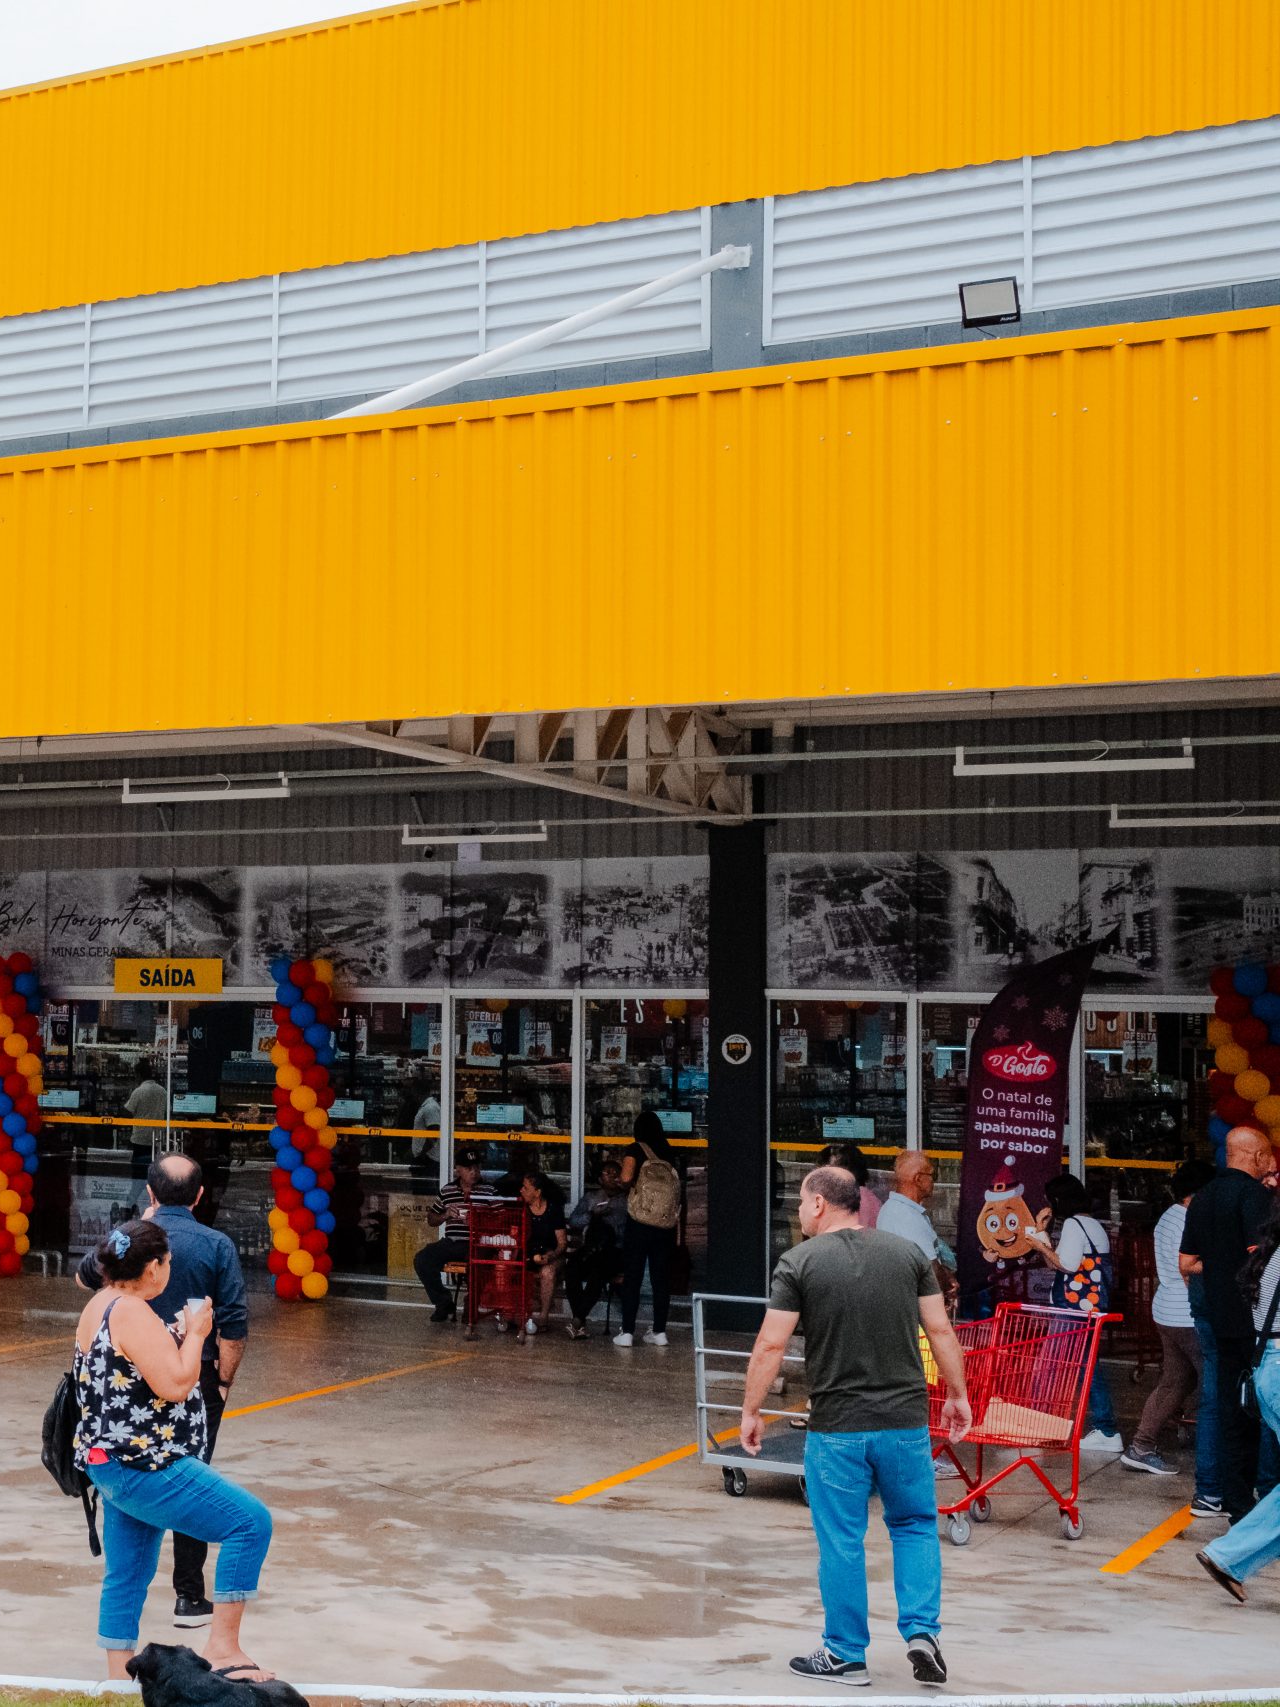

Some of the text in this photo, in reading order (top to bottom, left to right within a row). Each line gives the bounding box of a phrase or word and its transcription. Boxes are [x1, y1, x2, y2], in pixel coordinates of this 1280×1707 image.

[50, 900, 156, 942] Horizonte
[51, 947, 85, 957] MINAS
[139, 964, 196, 987] SAÍDA
[192, 1027, 203, 1040] 06
[492, 1031, 502, 1045] 08
[982, 1088, 1053, 1106] O natal de
[977, 1106, 1055, 1123] uma família
[974, 1121, 1056, 1139] apaixonada
[980, 1138, 1048, 1154] por sabor
